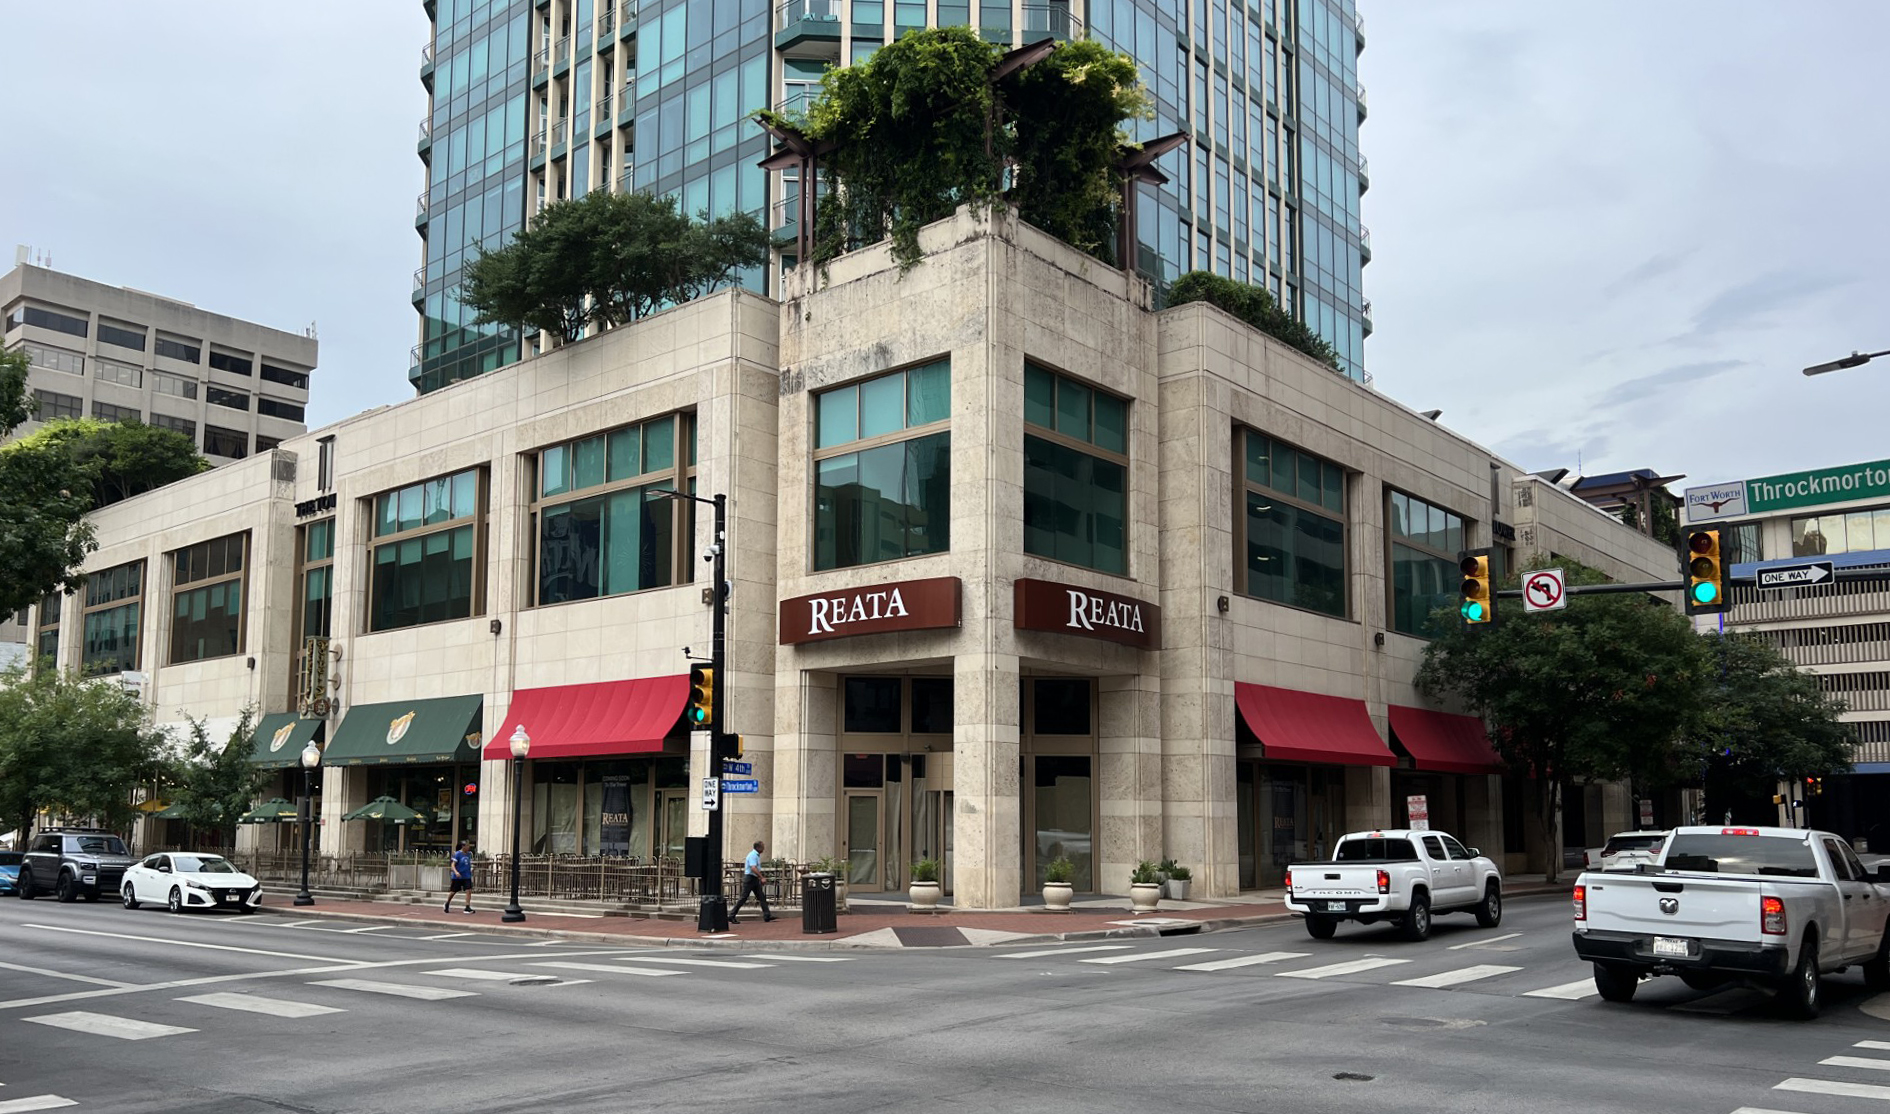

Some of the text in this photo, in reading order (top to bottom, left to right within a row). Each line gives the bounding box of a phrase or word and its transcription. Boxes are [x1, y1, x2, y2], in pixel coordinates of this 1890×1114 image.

[1764, 571, 1809, 583] ONE WAY
[735, 763, 746, 773] 4th
[704, 780, 716, 789] ONE
[704, 789, 716, 797] WAY
